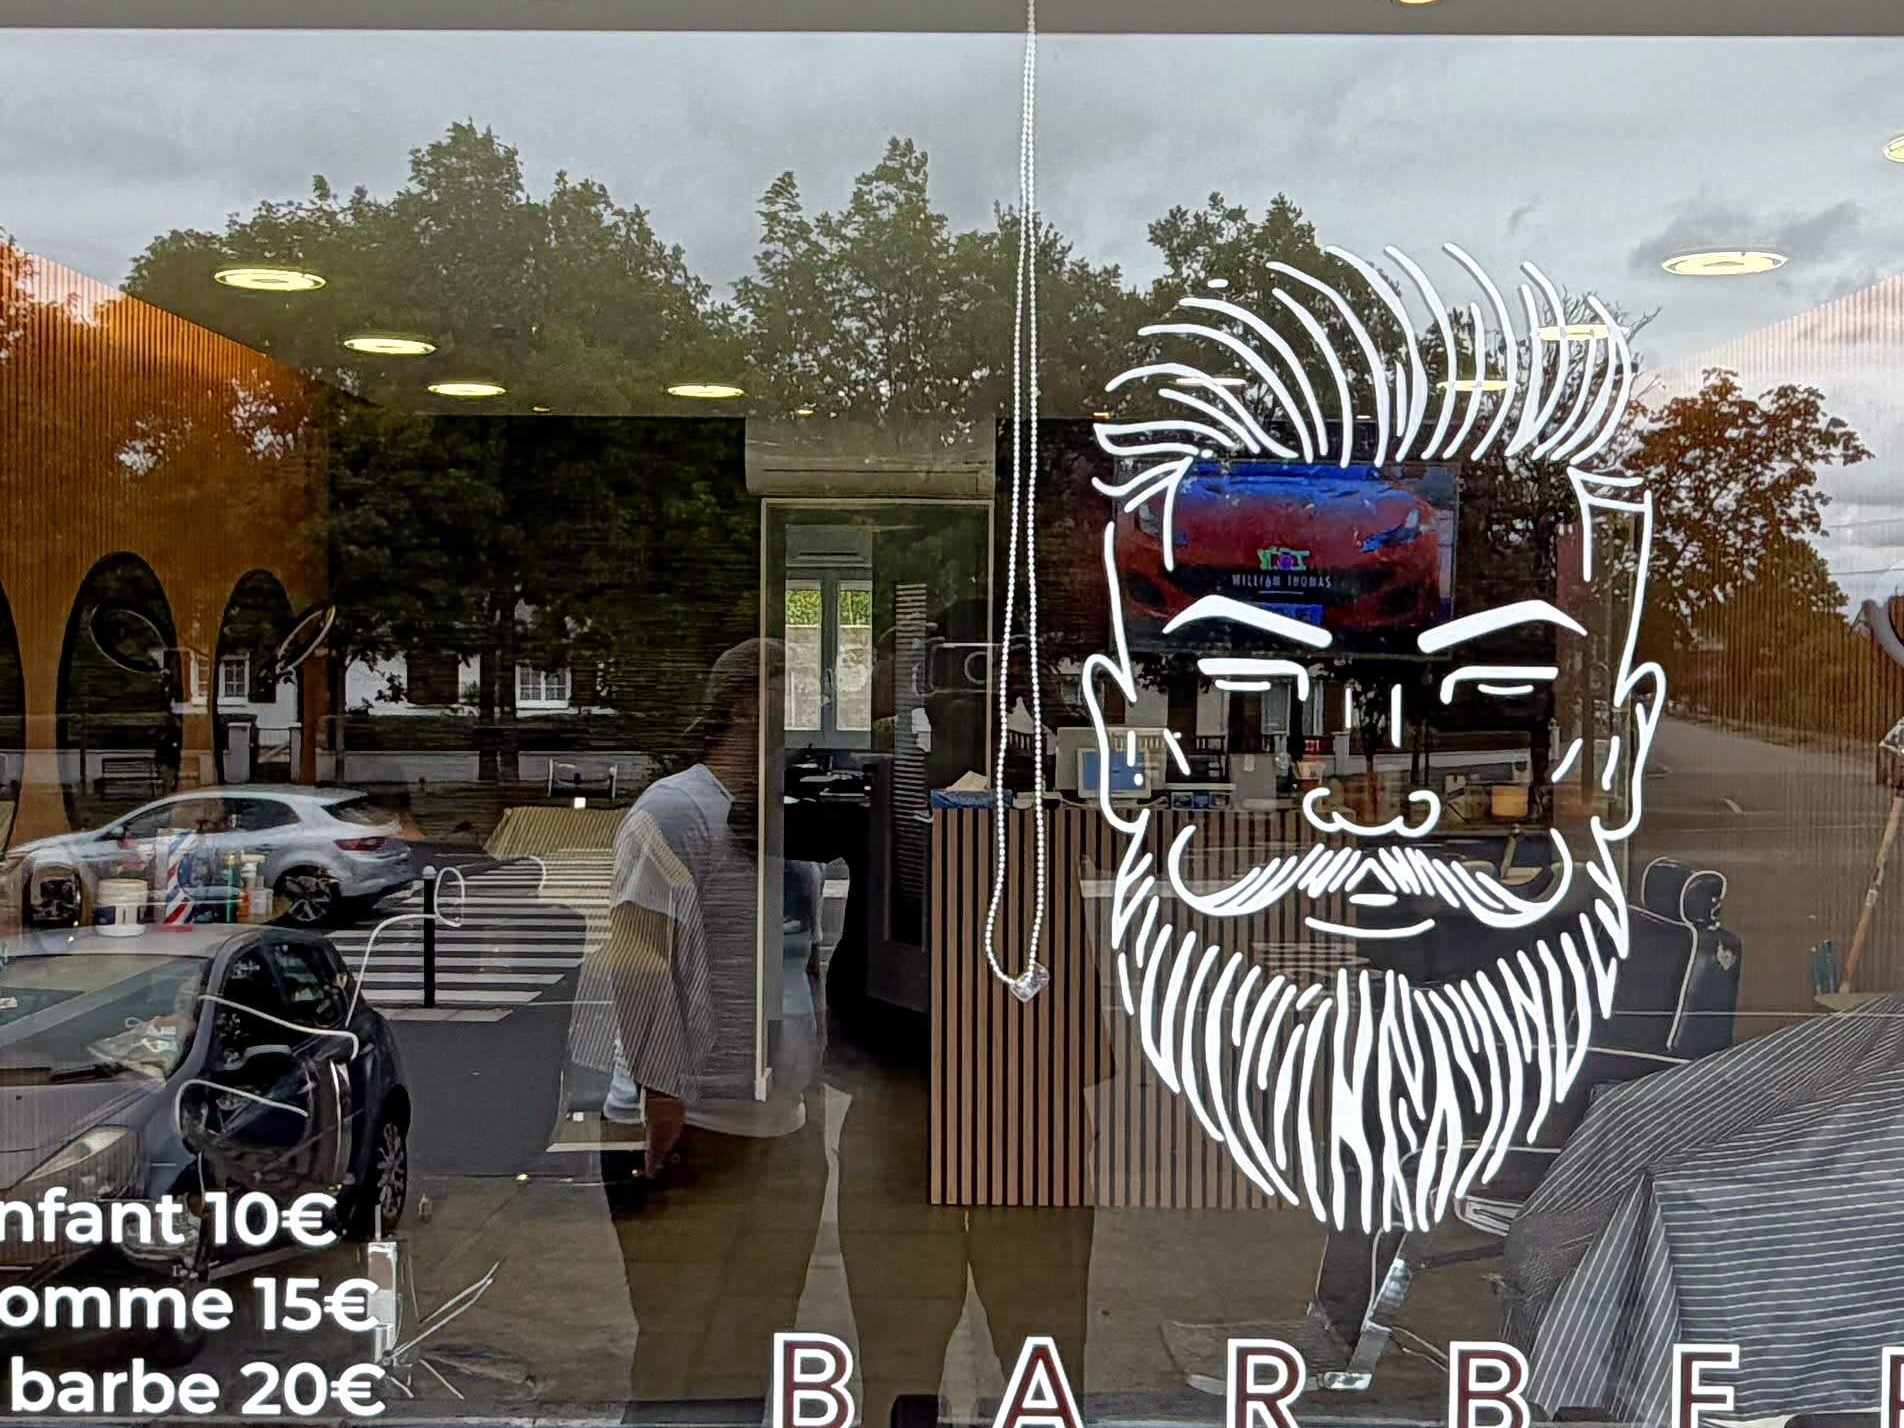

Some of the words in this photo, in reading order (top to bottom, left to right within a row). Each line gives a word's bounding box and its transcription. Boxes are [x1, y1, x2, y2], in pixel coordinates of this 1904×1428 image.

[204, 1191, 337, 1246] 10€
[253, 1277, 382, 1332] 15€
[11, 1356, 220, 1414] barbe
[240, 1361, 386, 1417] 20€
